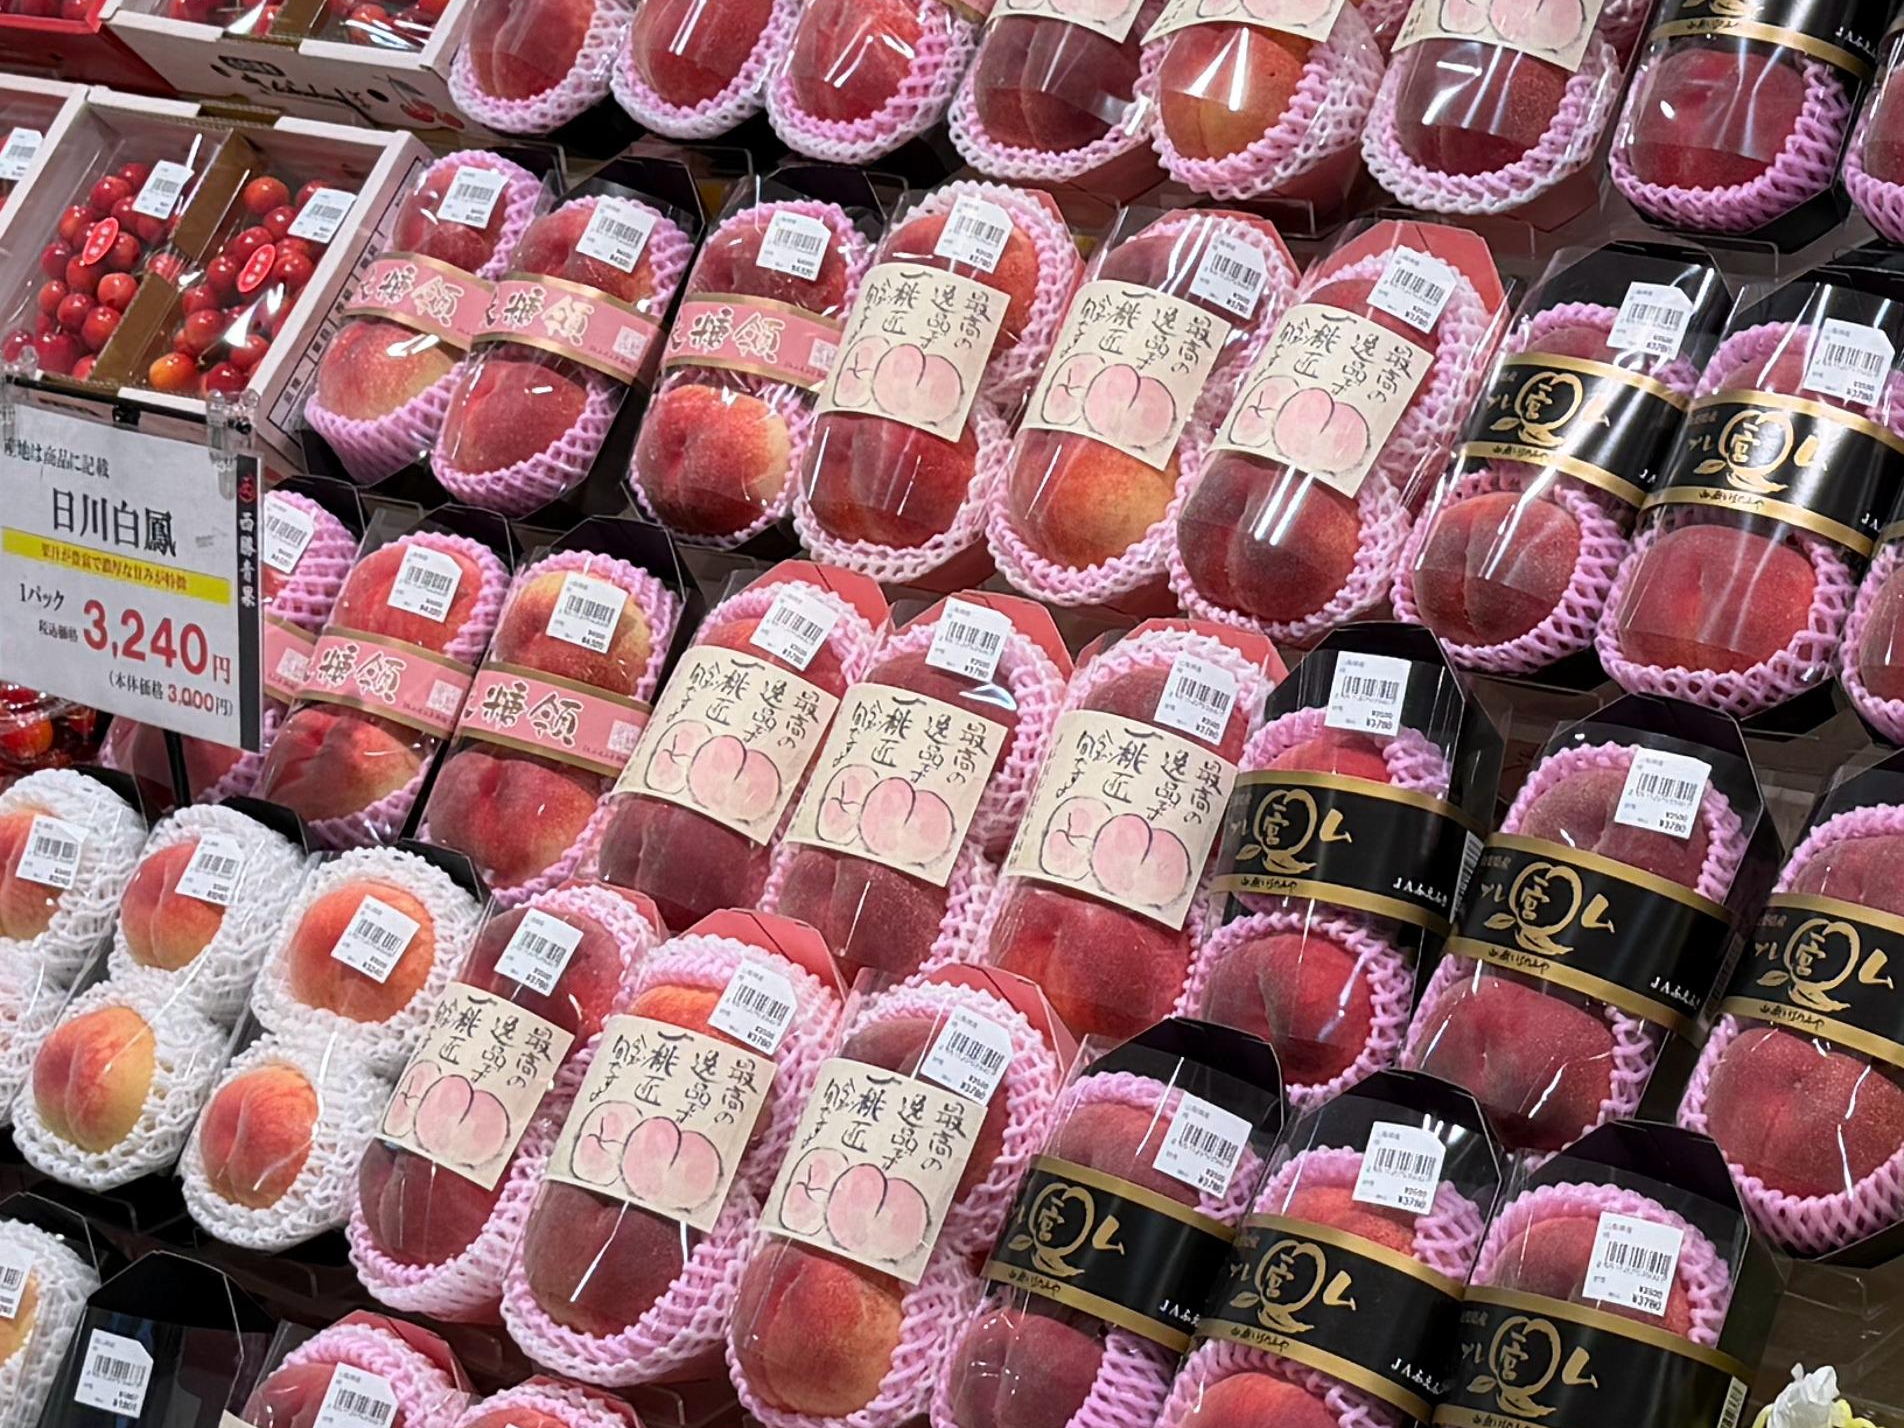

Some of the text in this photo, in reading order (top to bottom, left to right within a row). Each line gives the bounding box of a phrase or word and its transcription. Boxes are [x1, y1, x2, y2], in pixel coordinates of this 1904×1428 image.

[3, 438, 111, 479] 産地は商品に記載
[52, 487, 177, 557] 日川白鳳
[19, 582, 66, 613] 1パック
[39, 599, 232, 685] 税込価格 3,240円
[108, 670, 234, 717] (本体価格 3,000円)
[463, 679, 584, 748] 糖領
[776, 690, 820, 750] 最高の
